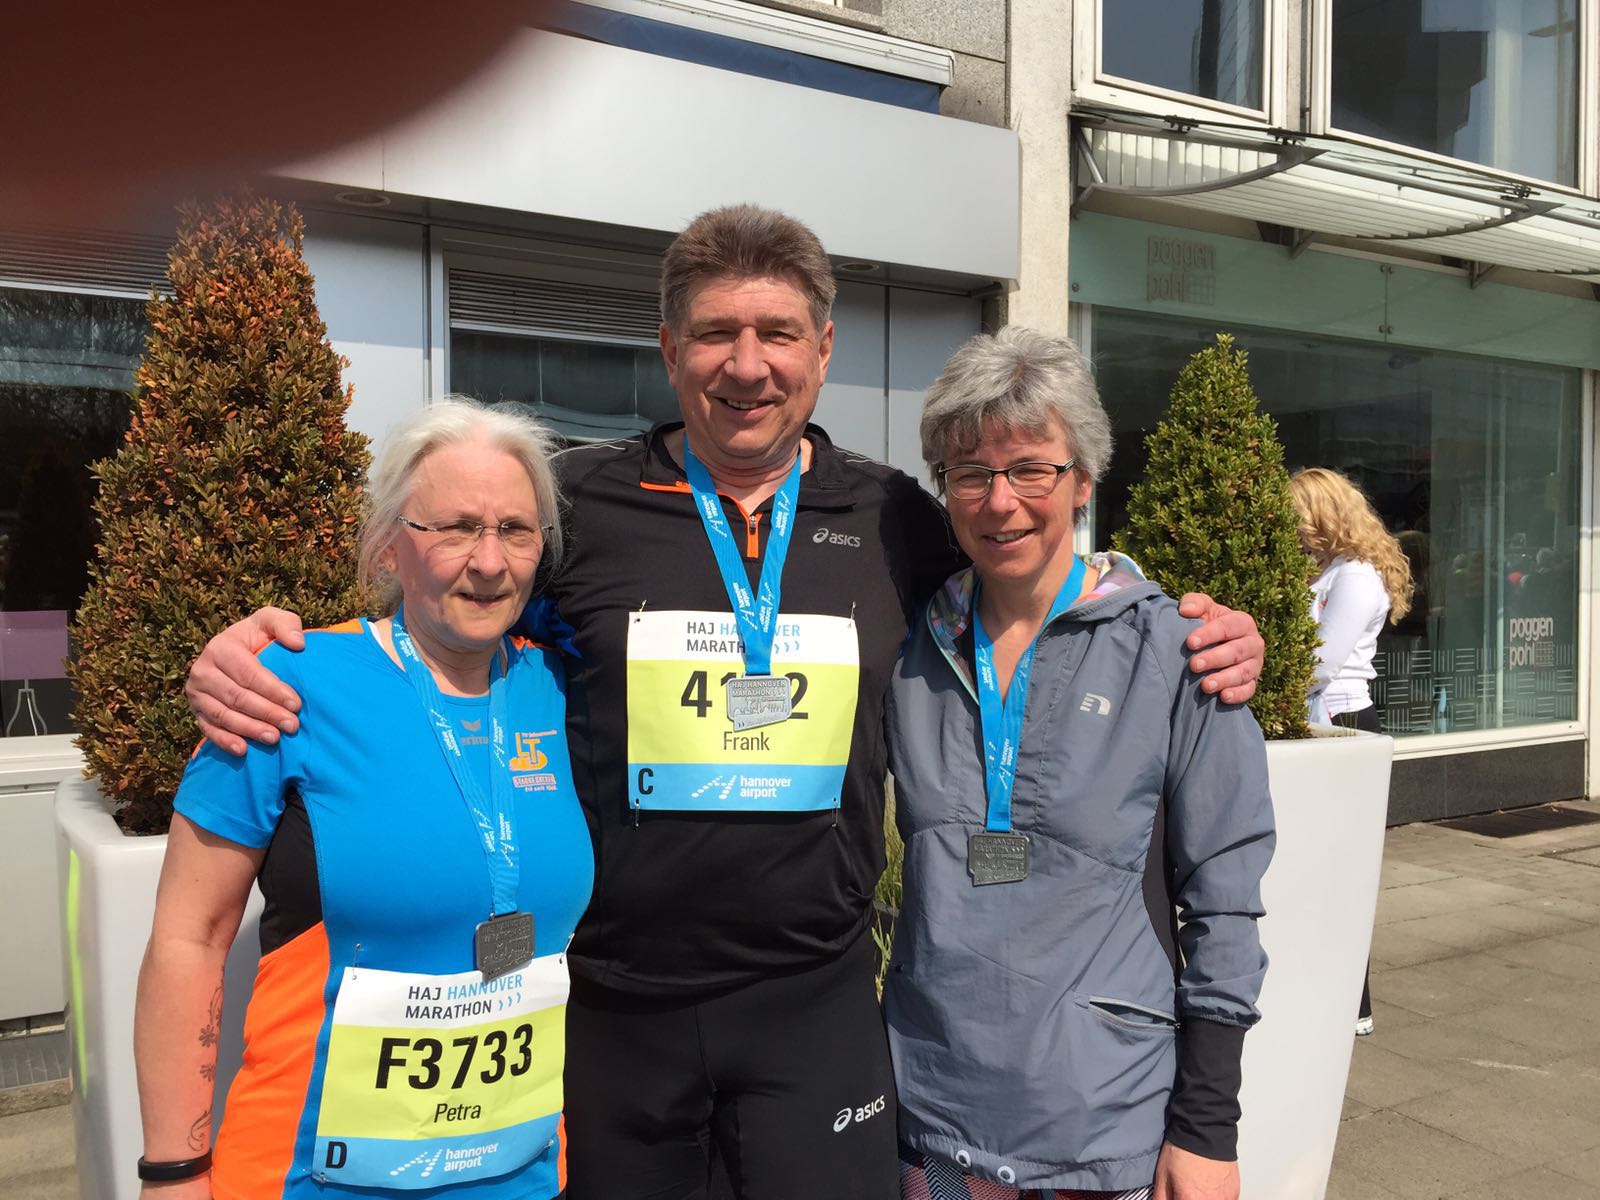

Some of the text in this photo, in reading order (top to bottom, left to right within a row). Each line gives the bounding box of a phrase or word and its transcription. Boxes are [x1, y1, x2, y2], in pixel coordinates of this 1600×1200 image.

[1146, 235, 1217, 273] poggen
[829, 532, 861, 548] asics
[687, 621, 715, 635] HAJ
[1509, 617, 1554, 642] poggen
[1509, 641, 1536, 671] pohl
[723, 731, 770, 751] Frank
[637, 767, 654, 795] C
[740, 774, 792, 789] hannover
[739, 787, 778, 800] airport
[408, 974, 523, 1001] HAJ HANNOVER
[405, 999, 493, 1020] MARATHON
[375, 1023, 535, 1090] F3733
[433, 1103, 482, 1124] Petra
[854, 1095, 886, 1123] asics
[325, 1141, 348, 1169] D
[445, 1142, 500, 1160] hannover
[443, 1156, 483, 1173] airport
